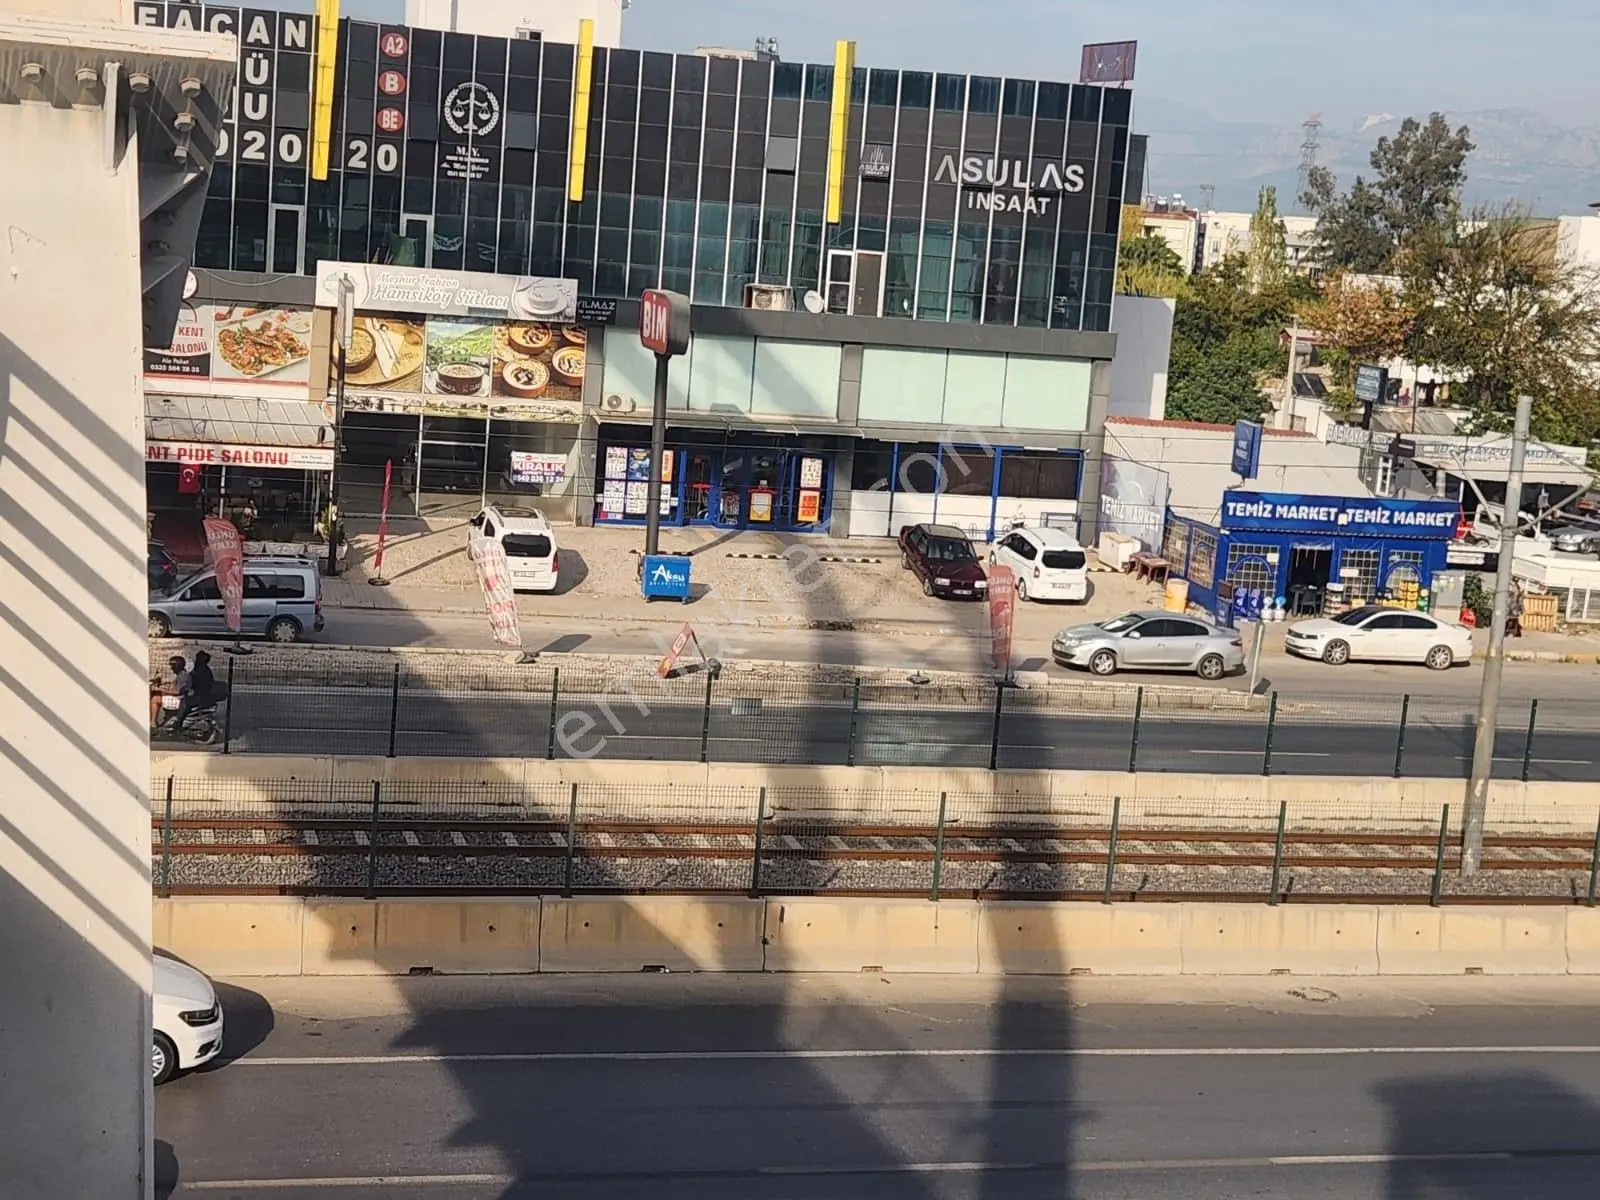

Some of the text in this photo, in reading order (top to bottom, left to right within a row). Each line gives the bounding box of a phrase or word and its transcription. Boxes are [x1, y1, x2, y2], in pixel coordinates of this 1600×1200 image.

[384, 36, 404, 54] A2
[384, 73, 399, 92] B
[382, 110, 398, 129] BE
[934, 155, 1085, 192] ASULAS
[643, 294, 667, 344] BİM
[178, 326, 204, 337] KENT
[169, 341, 208, 354] SALONU
[176, 444, 215, 462] PİDE
[220, 449, 289, 465] SALONU
[1101, 493, 1161, 532] TEMİZ MARKET
[1227, 501, 1338, 521] TEMİZ MARKET
[1346, 508, 1454, 527] TEMİZ MARKET
[651, 563, 686, 582] Aksu
